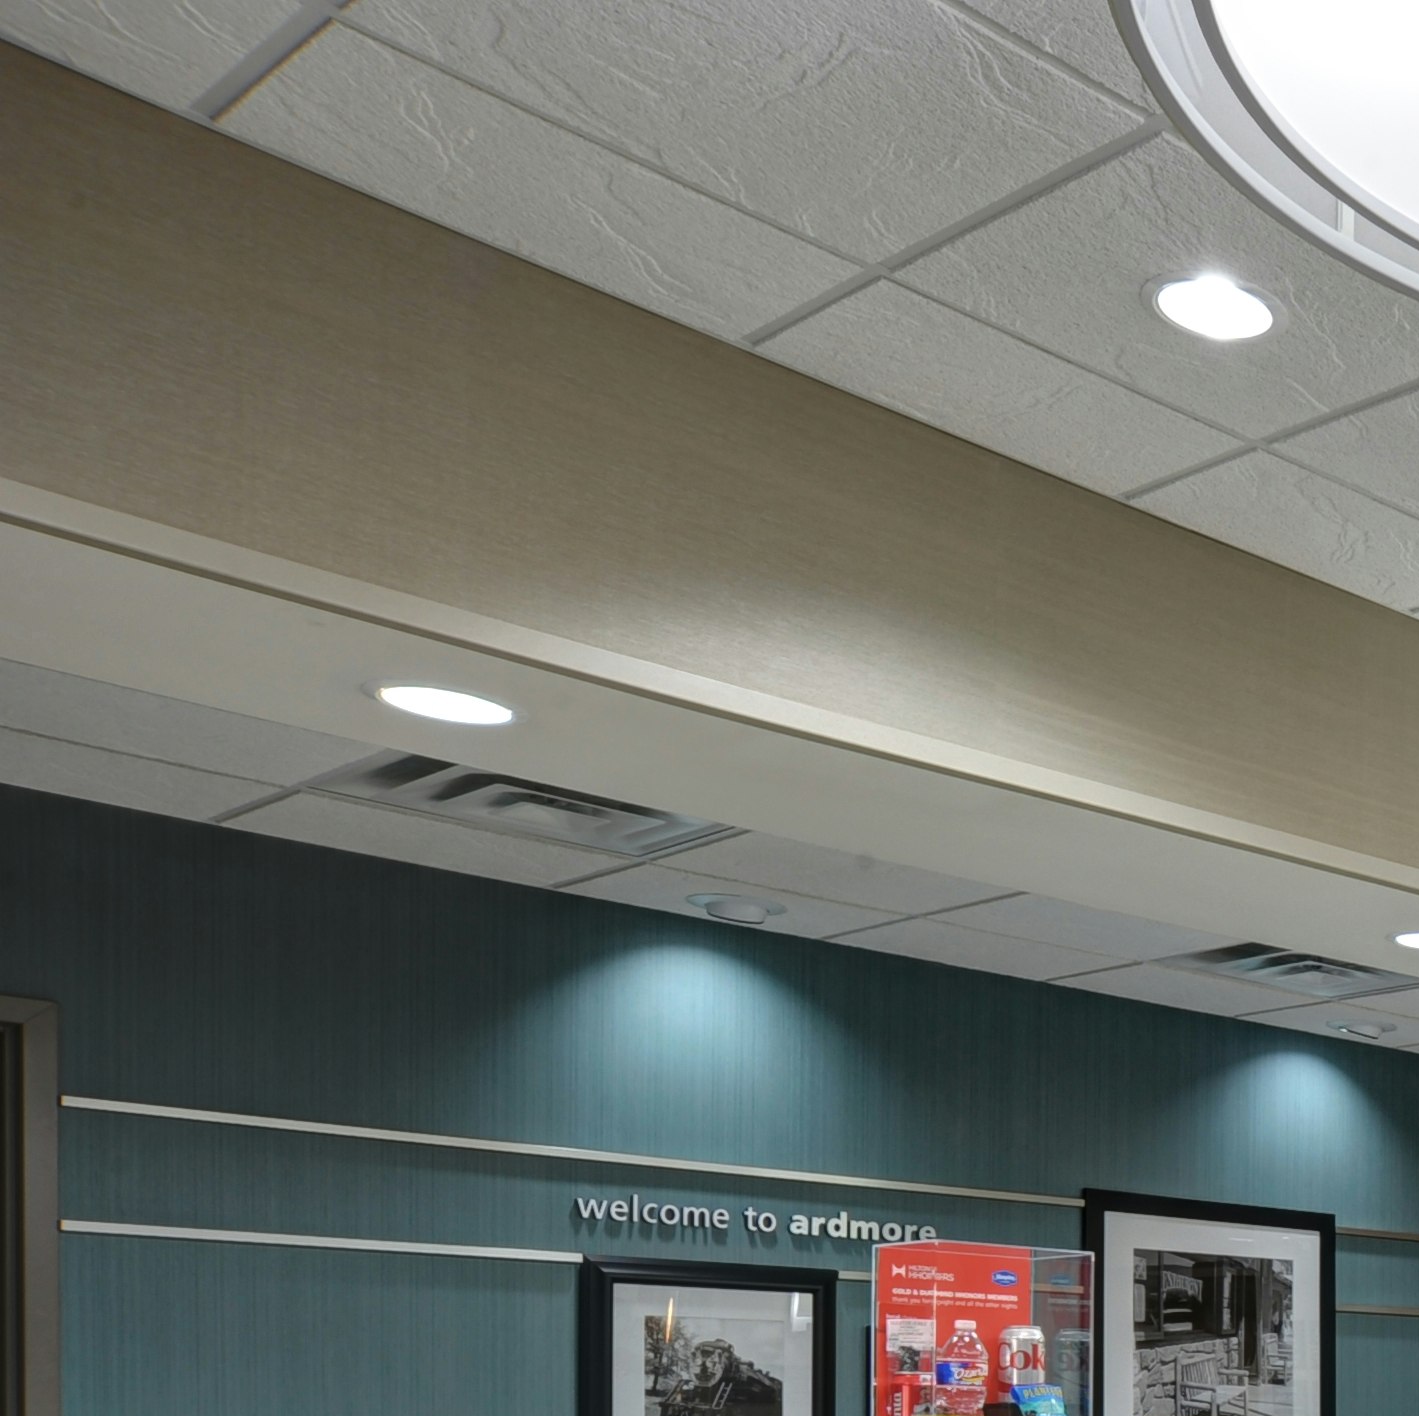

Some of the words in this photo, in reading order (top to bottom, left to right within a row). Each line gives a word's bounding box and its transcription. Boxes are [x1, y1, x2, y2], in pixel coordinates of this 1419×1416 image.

[576, 1194, 730, 1230] welcome
[744, 1205, 777, 1233] to
[789, 1212, 937, 1243] ardmore
